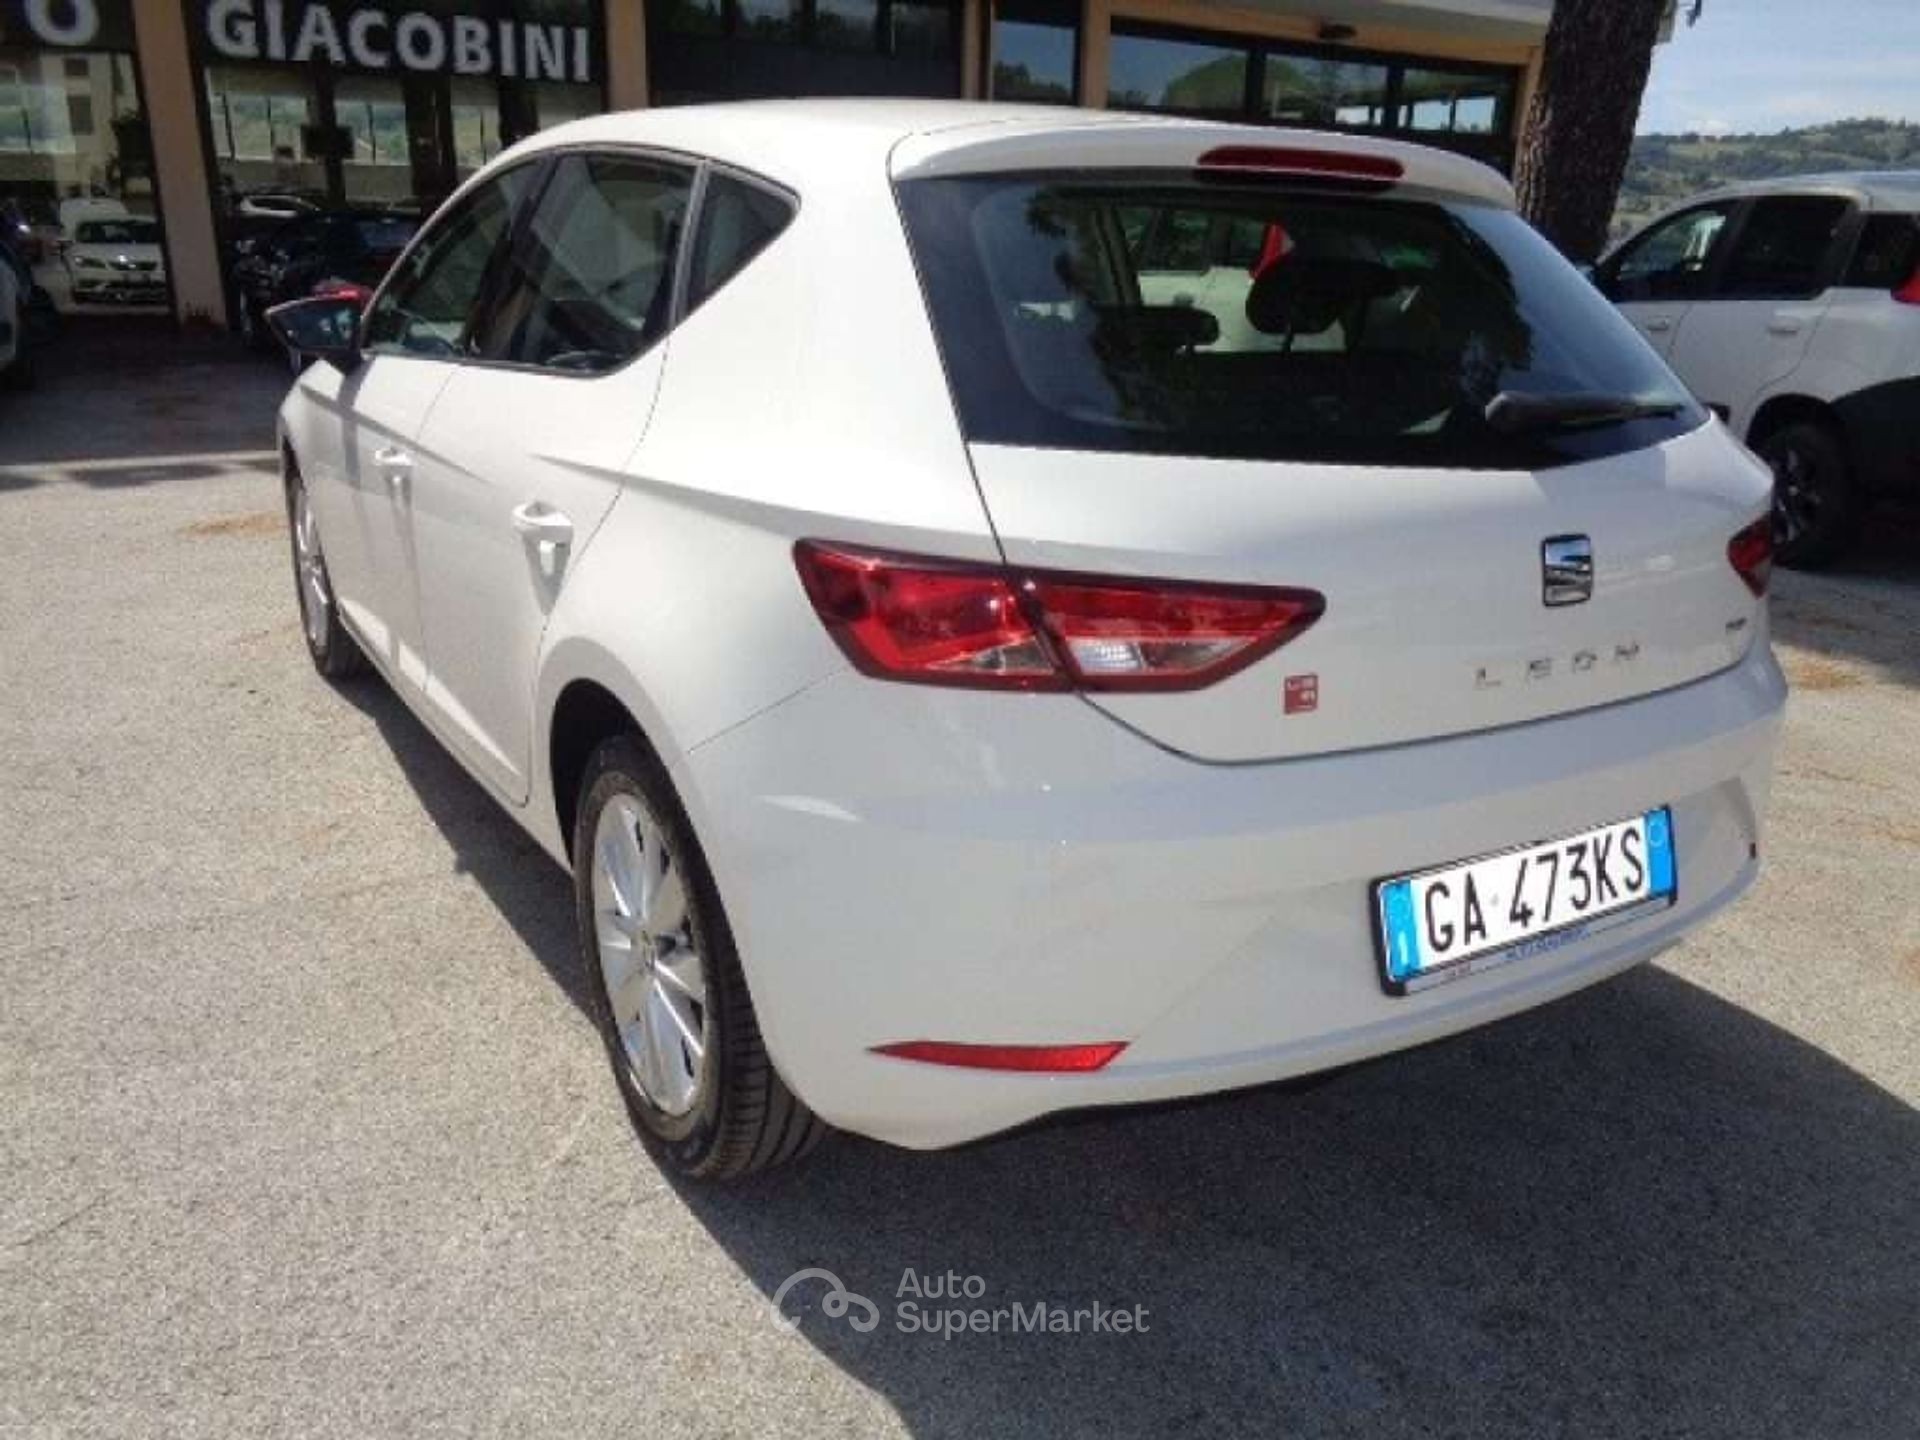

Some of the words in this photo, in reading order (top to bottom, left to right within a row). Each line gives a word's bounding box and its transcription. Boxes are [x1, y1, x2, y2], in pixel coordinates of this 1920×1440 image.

[207, 0, 591, 82] GIACOBINI
[1424, 871, 1488, 953] GA
[1508, 826, 1644, 929] 473KS
